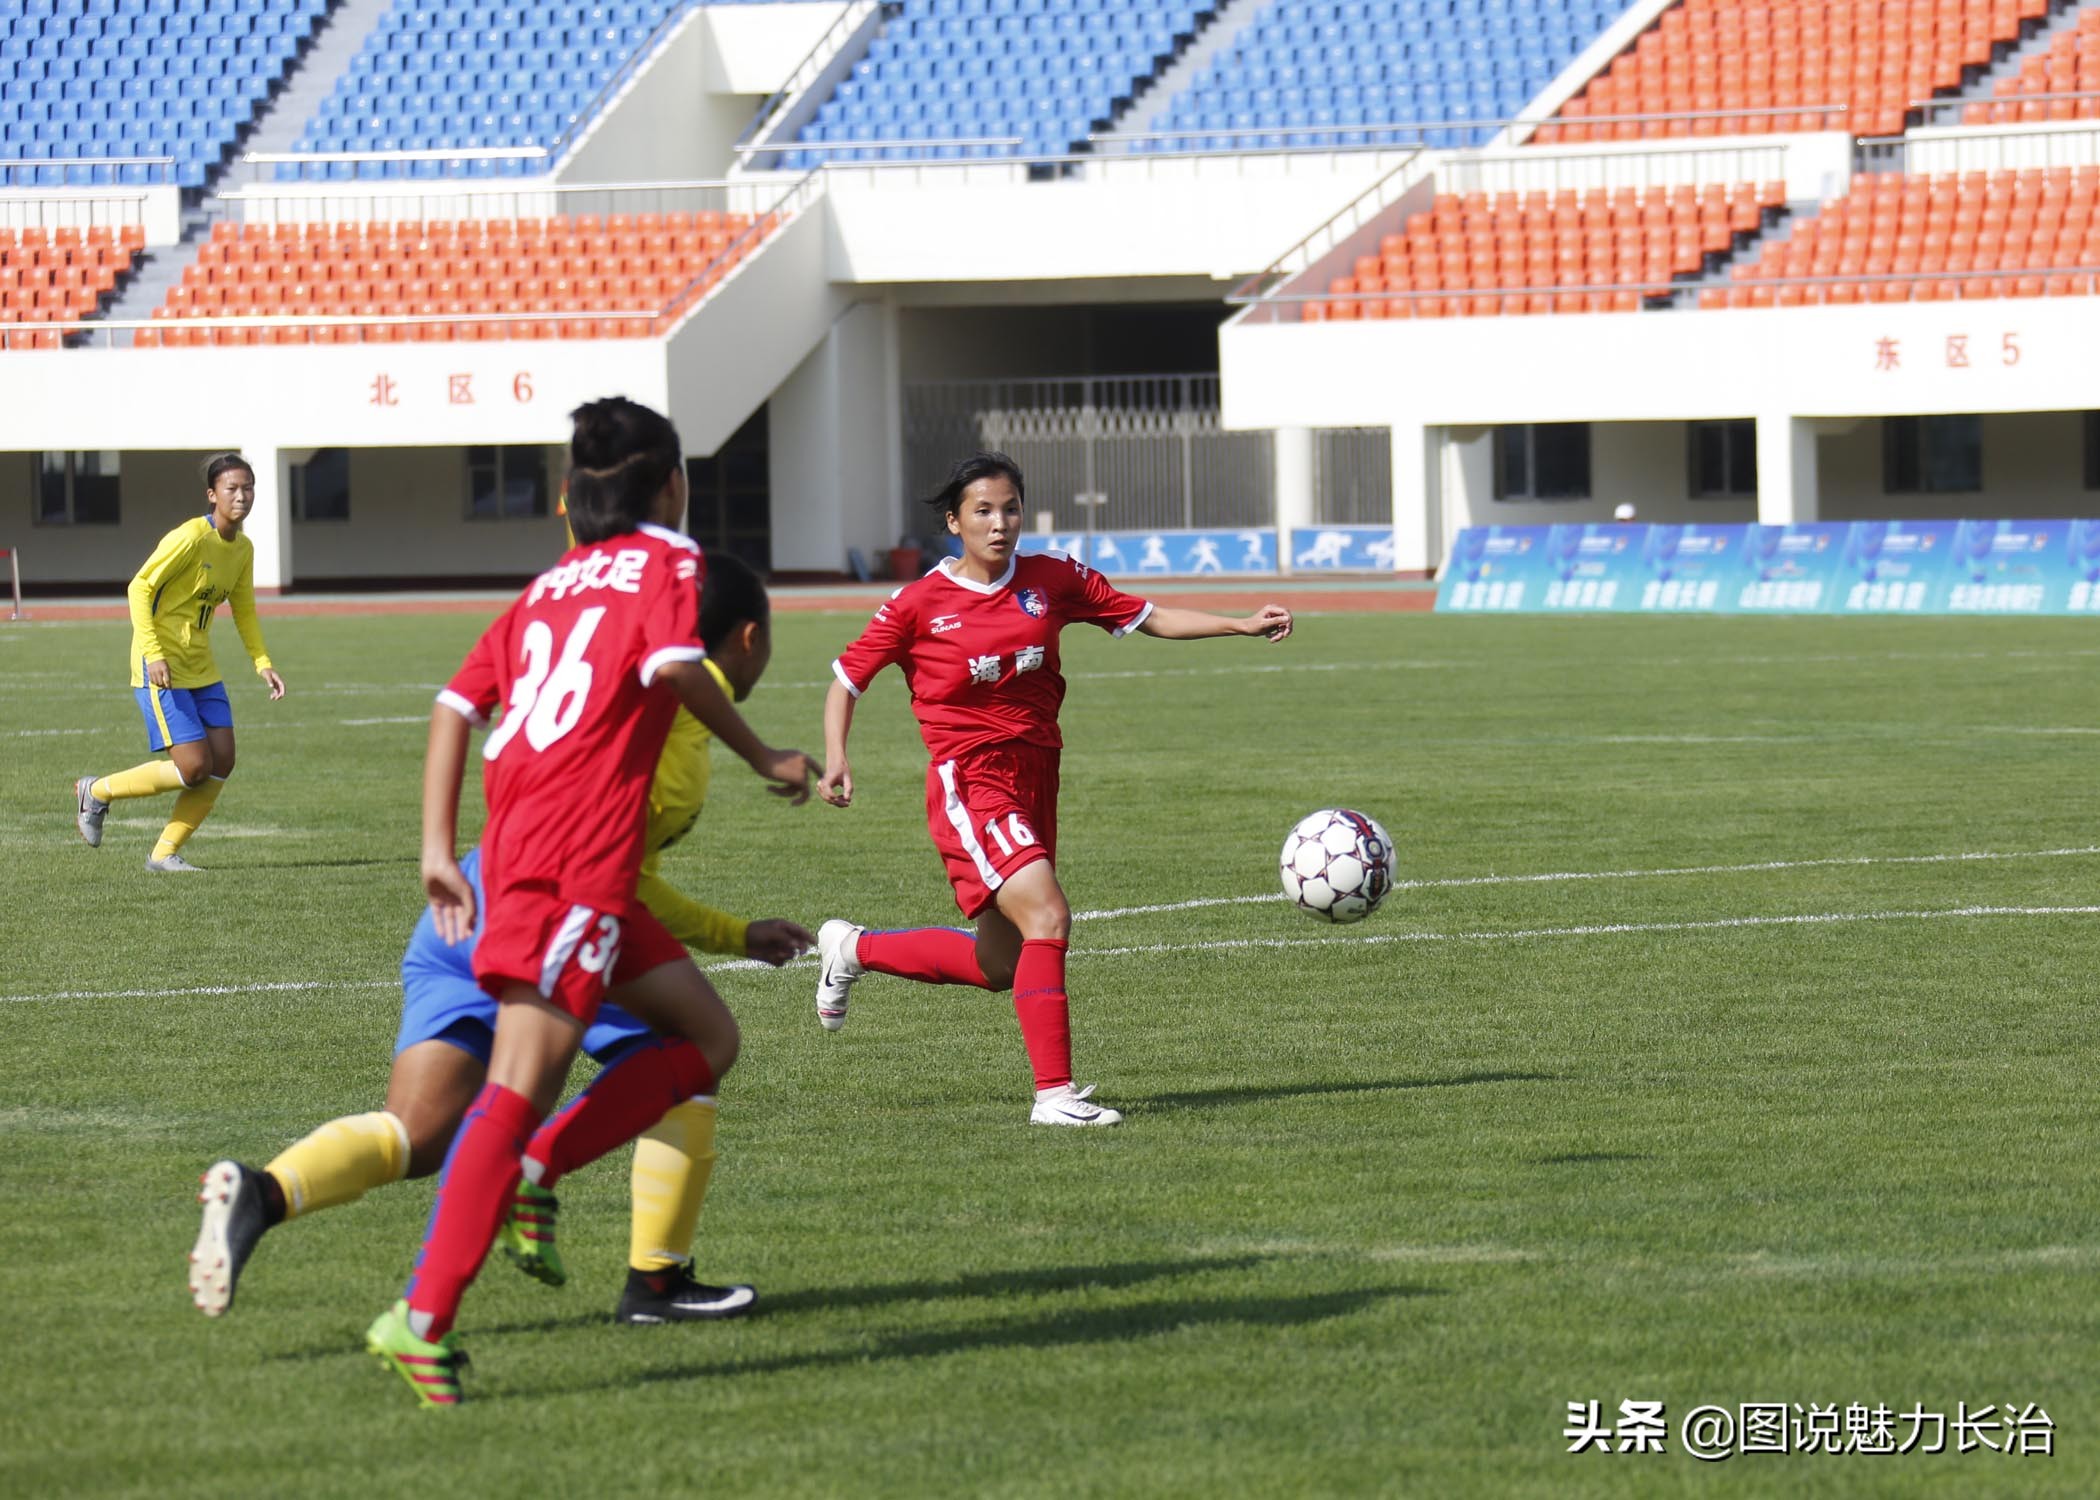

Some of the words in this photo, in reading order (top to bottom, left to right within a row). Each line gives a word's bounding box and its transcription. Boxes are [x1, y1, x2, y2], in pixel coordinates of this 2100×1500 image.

[483, 606, 607, 761] 36
[967, 645, 1045, 686] 海南
[985, 812, 1035, 857] 16
[577, 913, 621, 988] 3
